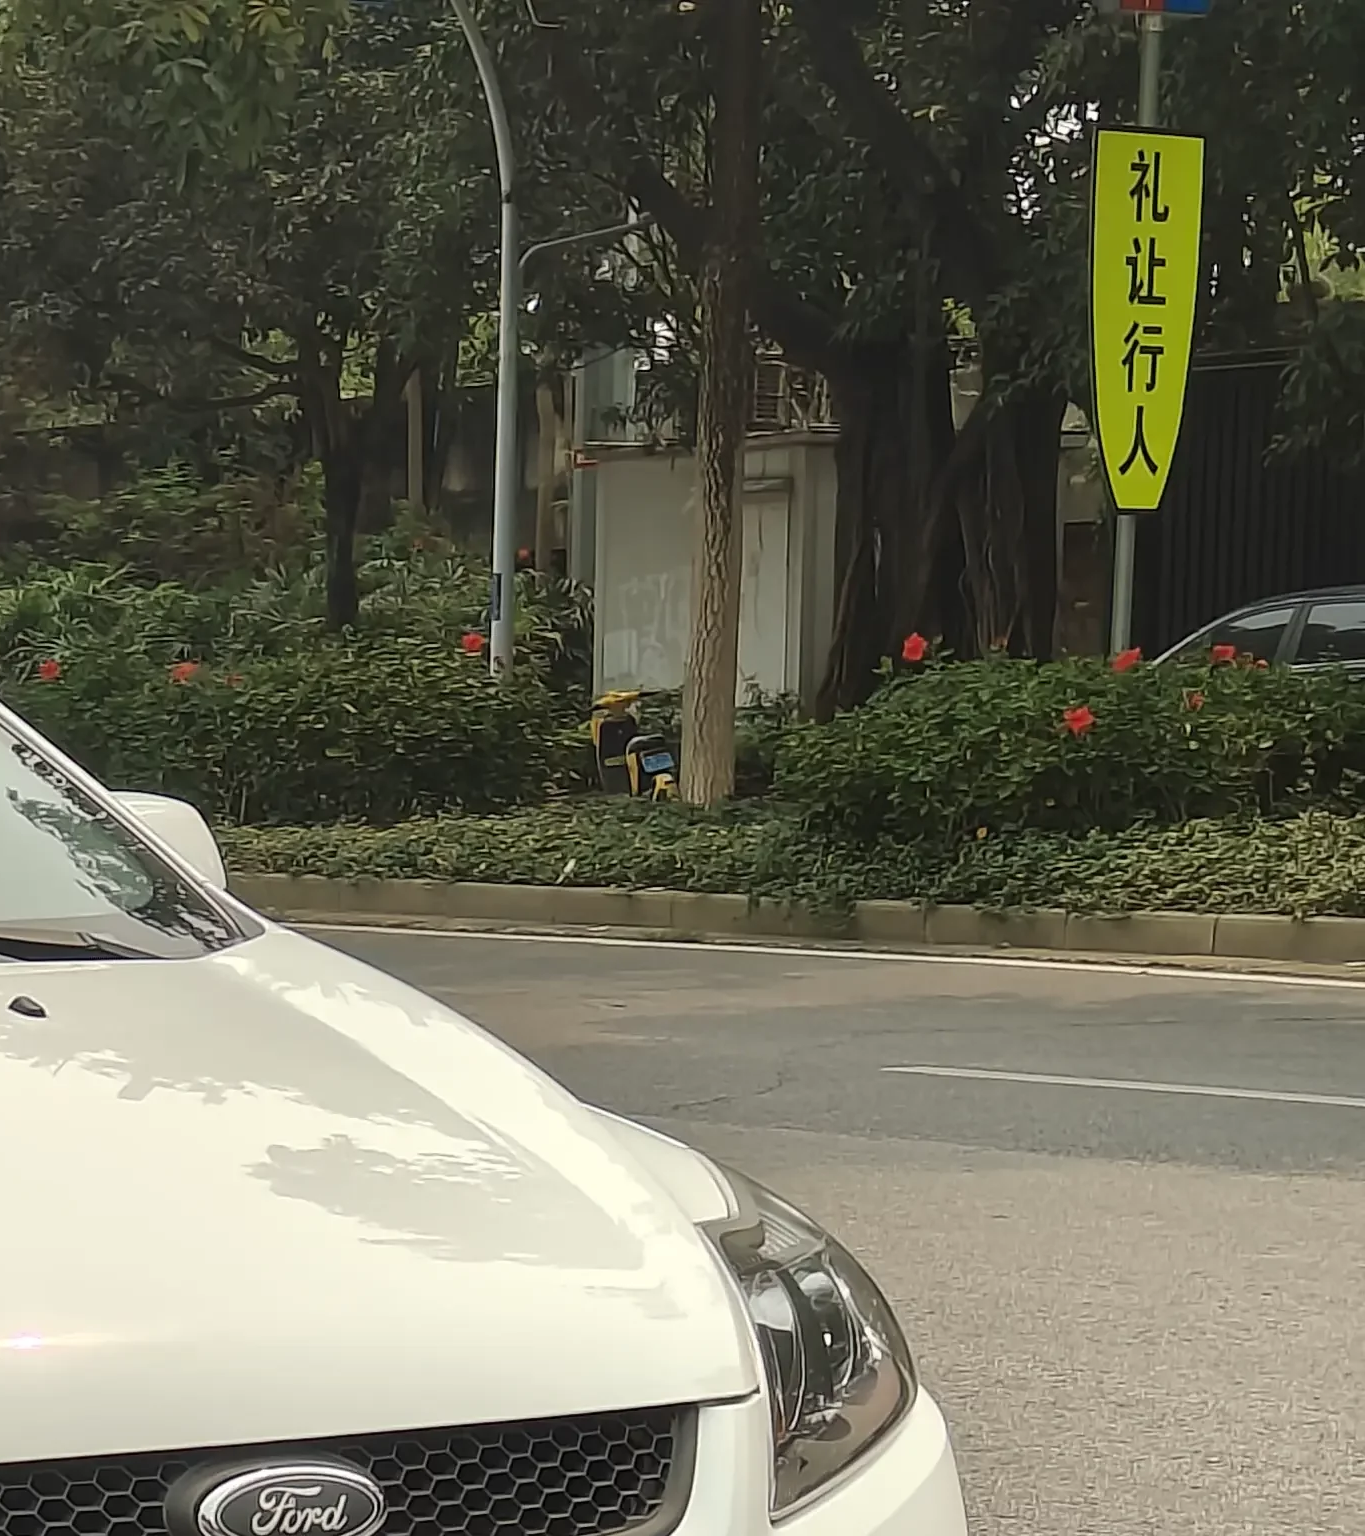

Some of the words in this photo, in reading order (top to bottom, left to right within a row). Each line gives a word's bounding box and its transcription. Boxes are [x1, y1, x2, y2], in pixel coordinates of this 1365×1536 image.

[1119, 149, 1170, 477] 礼让行人
[251, 1485, 348, 1536] Ford
